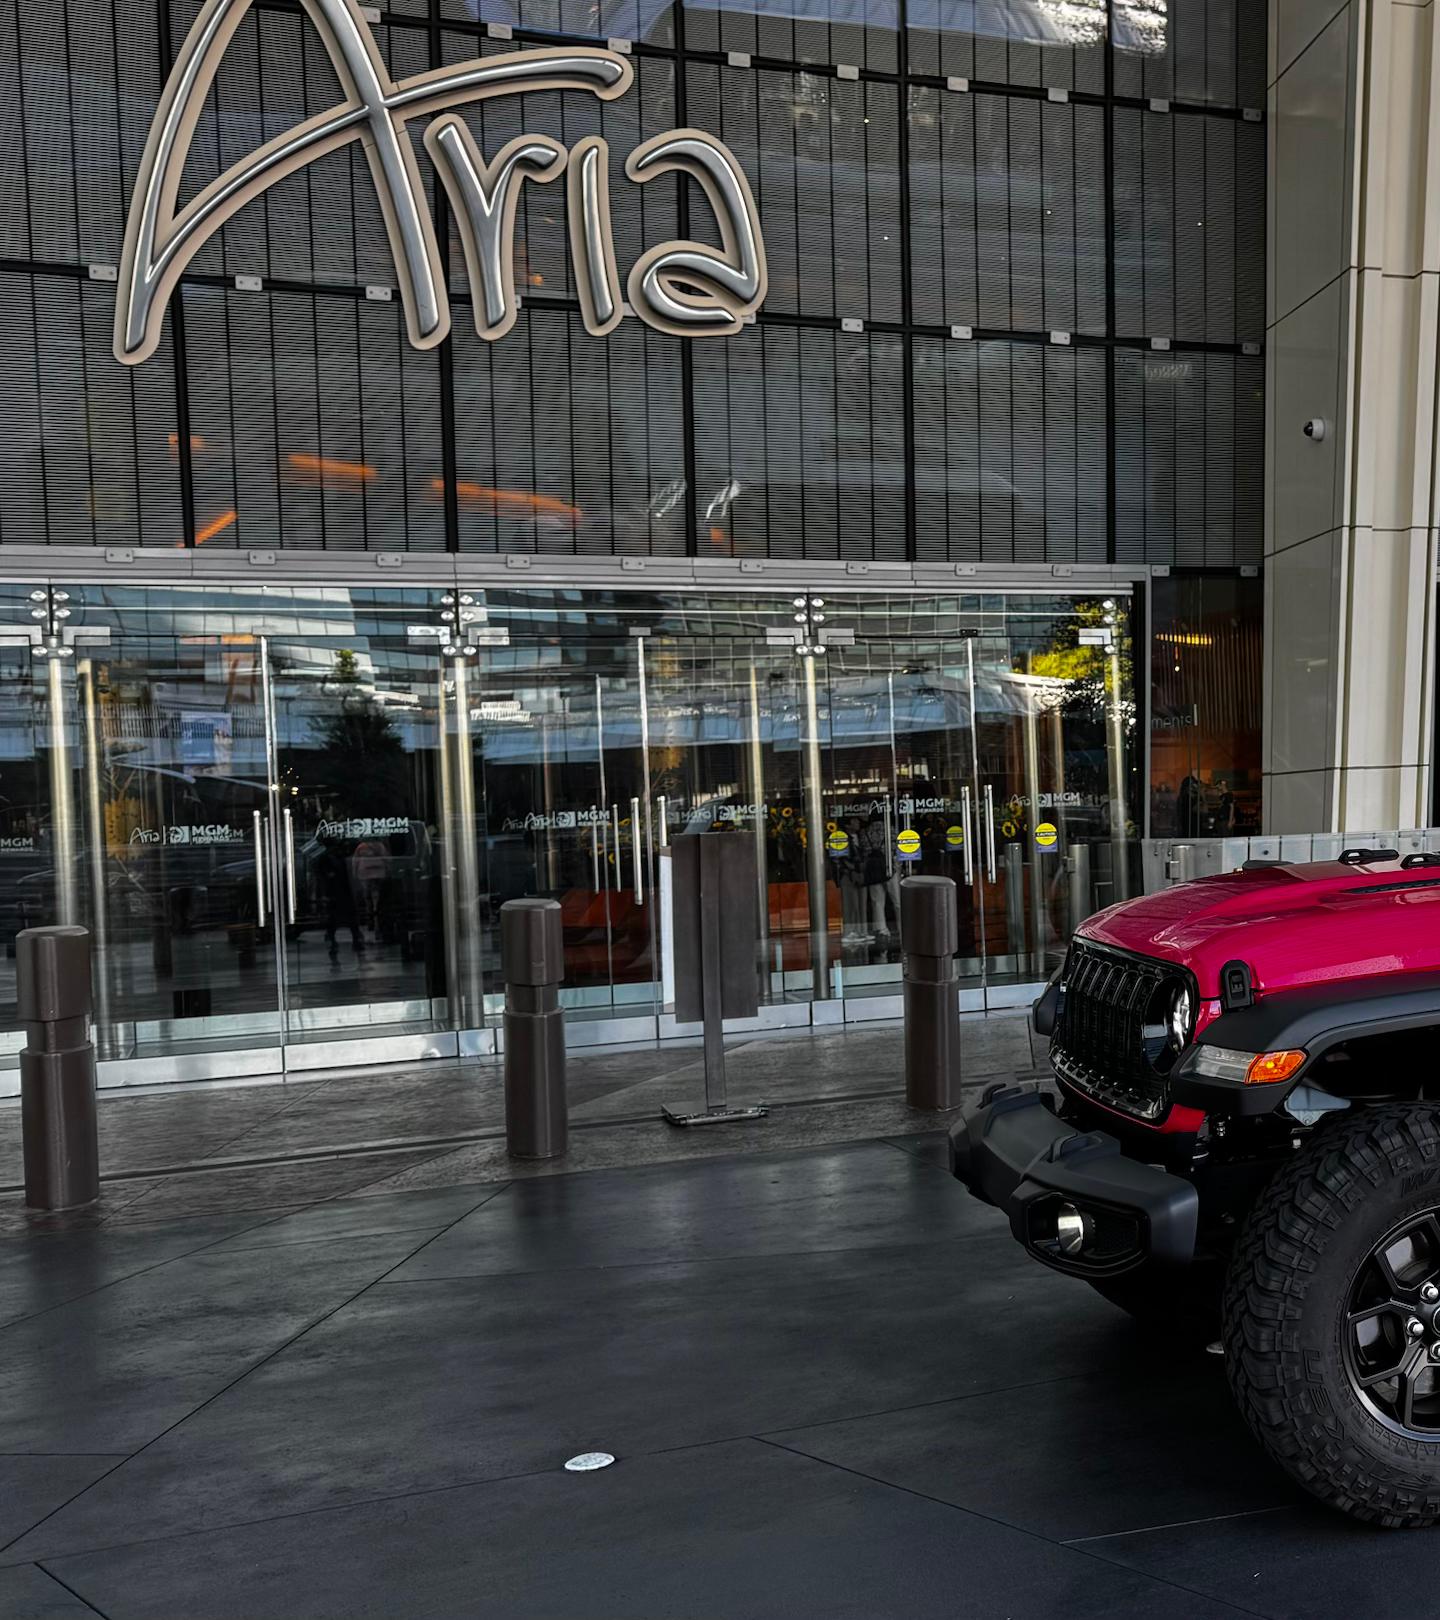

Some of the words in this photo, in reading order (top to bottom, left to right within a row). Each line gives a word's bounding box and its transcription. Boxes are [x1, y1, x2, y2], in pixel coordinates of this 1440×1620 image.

[114, 0, 768, 365] Aria
[1053, 792, 1080, 801] MGM
[915, 799, 944, 808] MGM
[578, 810, 610, 820] MGM
[374, 817, 409, 828] MGM
[192, 824, 229, 836] MGM
[129, 827, 160, 845] Aria
[0, 837, 34, 847] MGM
